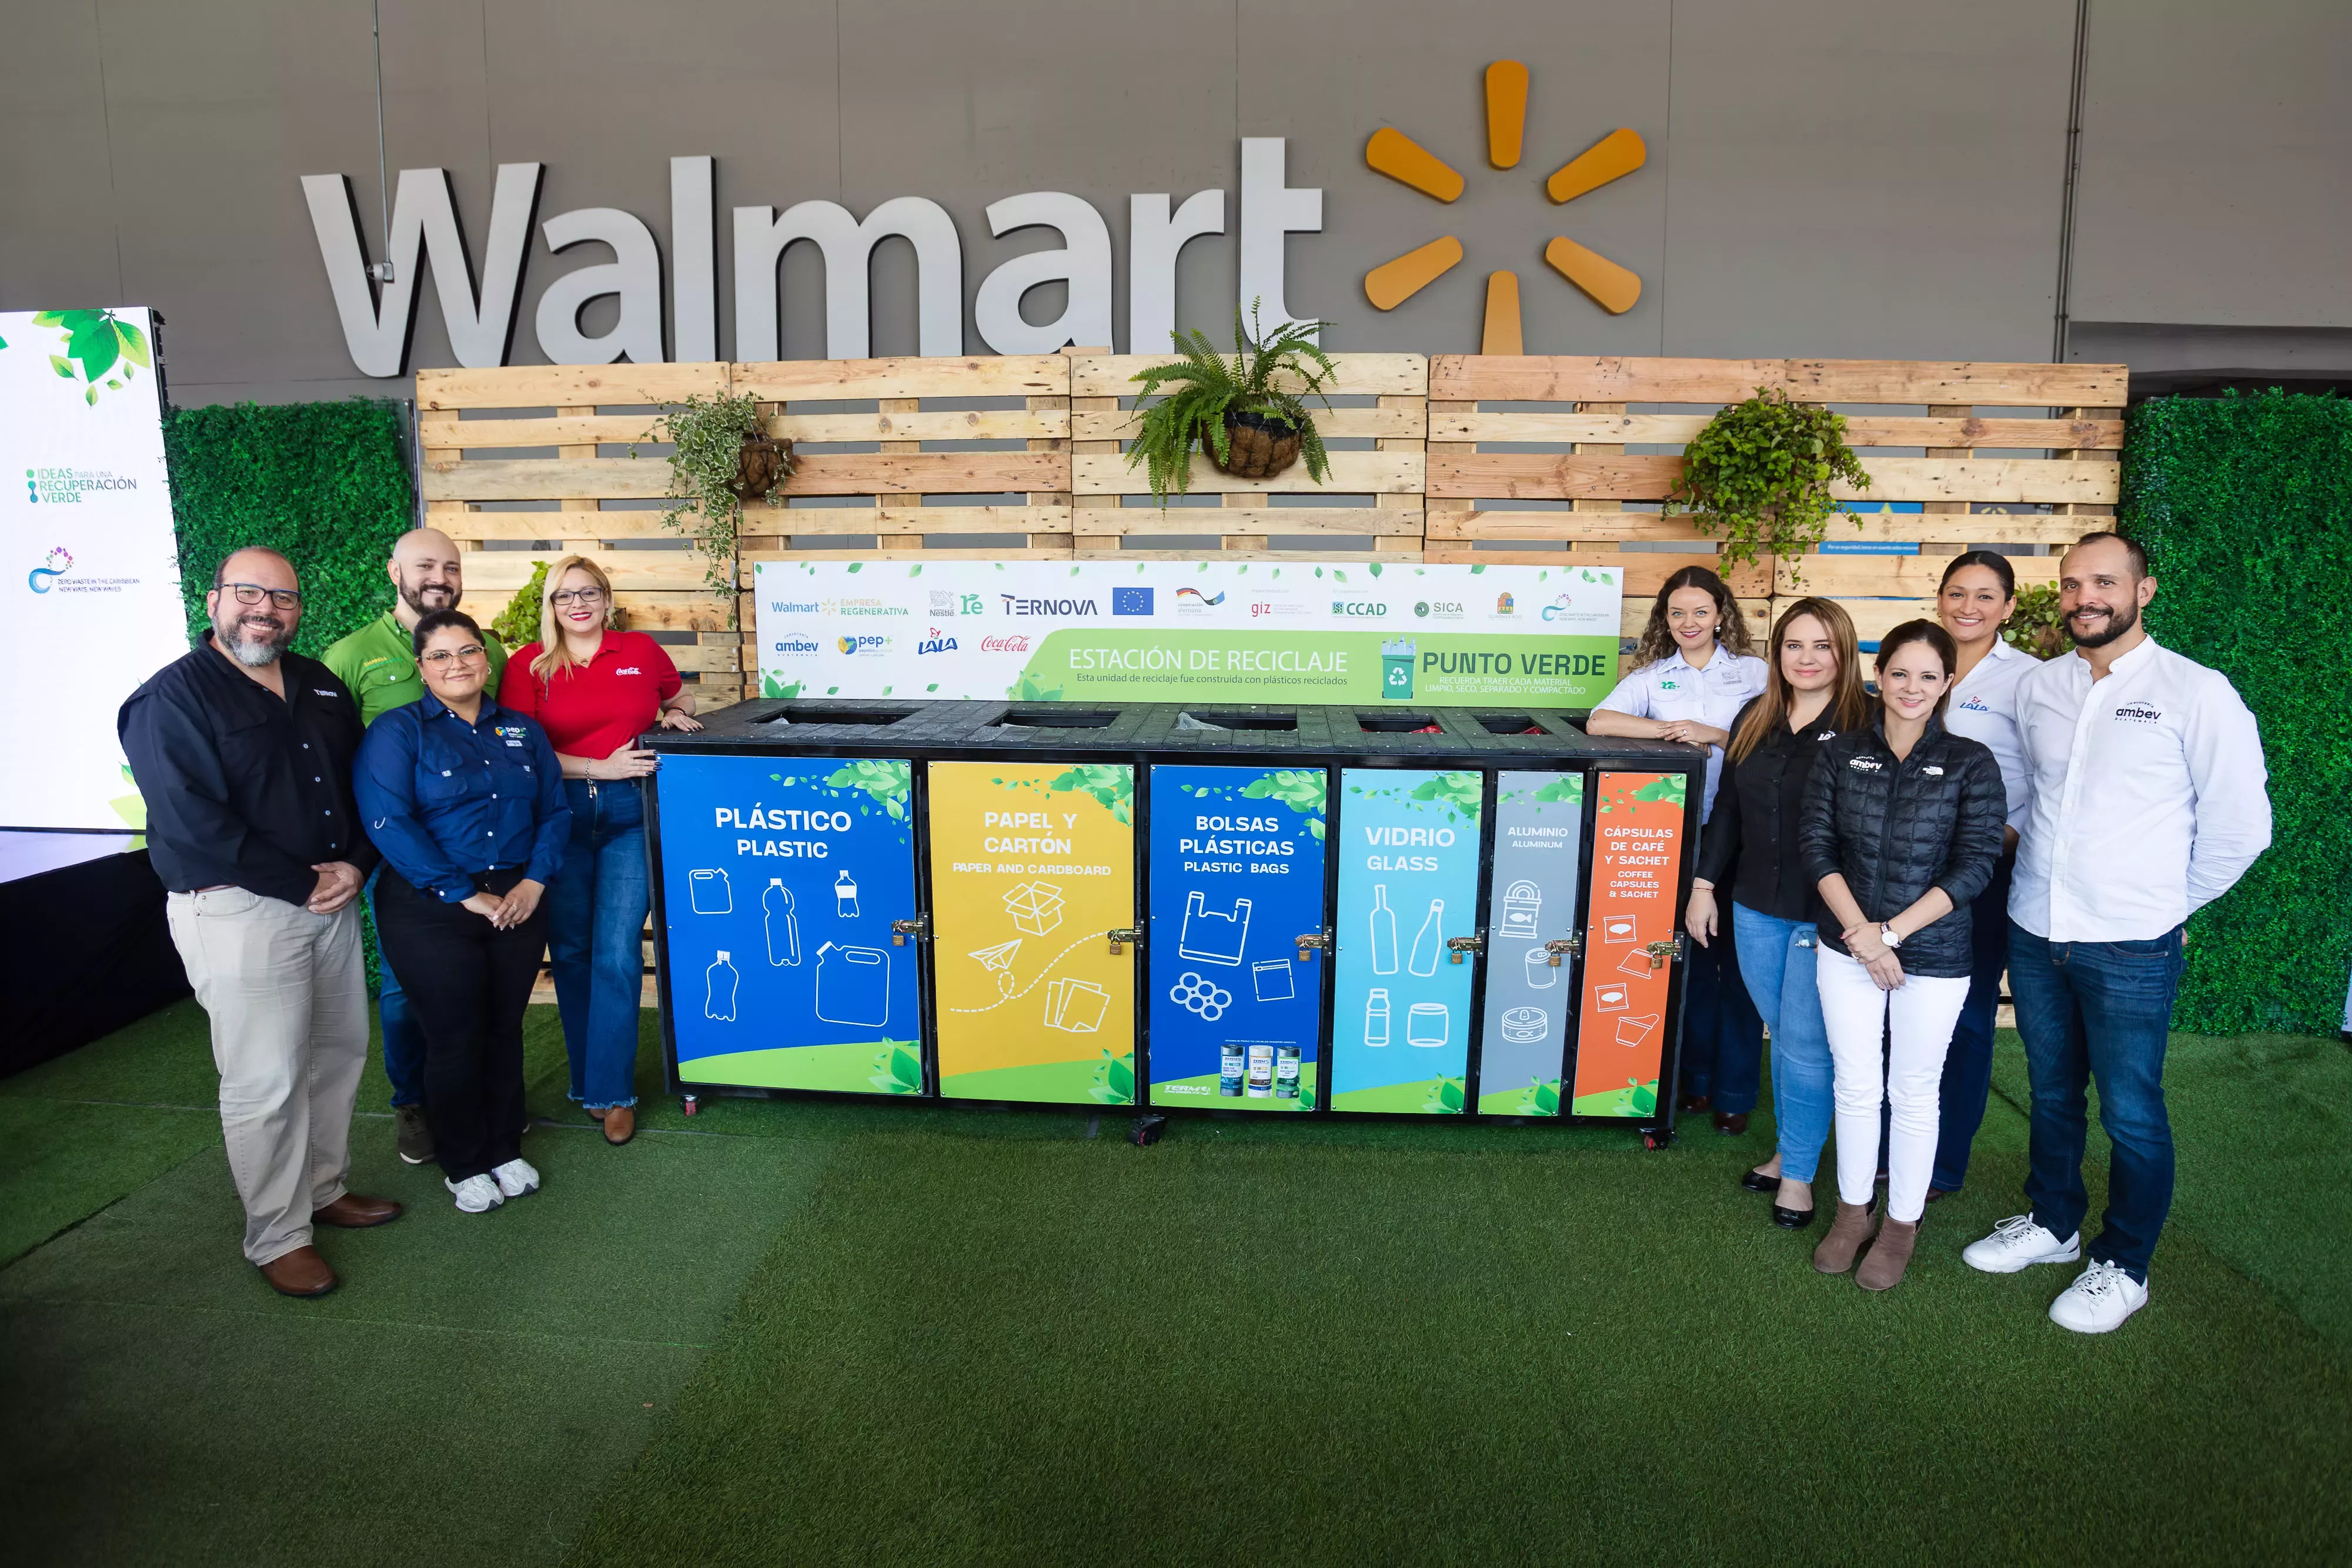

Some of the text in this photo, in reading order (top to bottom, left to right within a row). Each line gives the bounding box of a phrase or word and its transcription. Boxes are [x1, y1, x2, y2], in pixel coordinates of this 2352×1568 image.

[300, 137, 1325, 377] Walmart
[38, 468, 73, 479] IDEAS
[39, 476, 137, 492] RECUPERACIÓN
[42, 492, 82, 503] VERDE
[771, 601, 819, 612] Walmart
[1001, 594, 1098, 615] TERNOVA
[1252, 601, 1271, 617] giz
[1347, 603, 1387, 616] CCAD
[1434, 602, 1464, 612] SICA
[930, 609, 954, 617] Nestlé
[775, 640, 819, 651] ambev
[918, 638, 958, 654] LALA
[981, 636, 1031, 651] Coca-Cola
[1070, 645, 1348, 672] ESTACIÓN DE RECICLAJE
[1423, 652, 1606, 676] PUNTO VERDE
[1077, 674, 1094, 682] Esta
[1097, 673, 1127, 682] unidad
[1130, 674, 1141, 682] de
[1142, 674, 1178, 685] reciclaje
[1180, 674, 1195, 683] fue
[1197, 674, 1242, 684] construida
[1264, 674, 1302, 686] plásticos
[1304, 676, 1348, 685] reciclados
[1439, 677, 1482, 685] RECUERDA
[1483, 677, 1508, 686] TRAER
[1534, 678, 1572, 686] MATERIAL
[1425, 684, 1454, 693] LIMPIO,
[1456, 685, 1478, 694] SECO,
[1480, 686, 1522, 694] SEPARADO
[1528, 686, 1586, 694] COMPACTADO
[1959, 702, 1988, 711] LALA
[2116, 707, 2161, 720] ambev
[715, 803, 852, 833] PLÁSTICO
[984, 811, 1078, 830] PAPEL Y
[1196, 815, 1279, 833] BOLSAS
[1365, 826, 1456, 847] VIDRIO
[1507, 826, 1569, 838] ALUMINIO
[1603, 825, 1673, 838] CÁPSULAS
[737, 840, 828, 859] PLASTIC
[984, 832, 1071, 855] CARTÓN
[1180, 835, 1295, 856] PLÁSTICAS
[1512, 840, 1563, 849] ALUMINUM
[1611, 840, 1665, 852] DE CAFÉ
[1367, 855, 1439, 872] GLASS
[1604, 855, 1670, 866] Y SACHET
[953, 862, 1112, 877] PAPER AND CARDBOARD
[1184, 861, 1290, 874] PLASTIC BAGS
[1618, 871, 1653, 879] COFFEE
[1609, 880, 1659, 889] CAPSULES
[1620, 891, 1659, 899] SACHET
